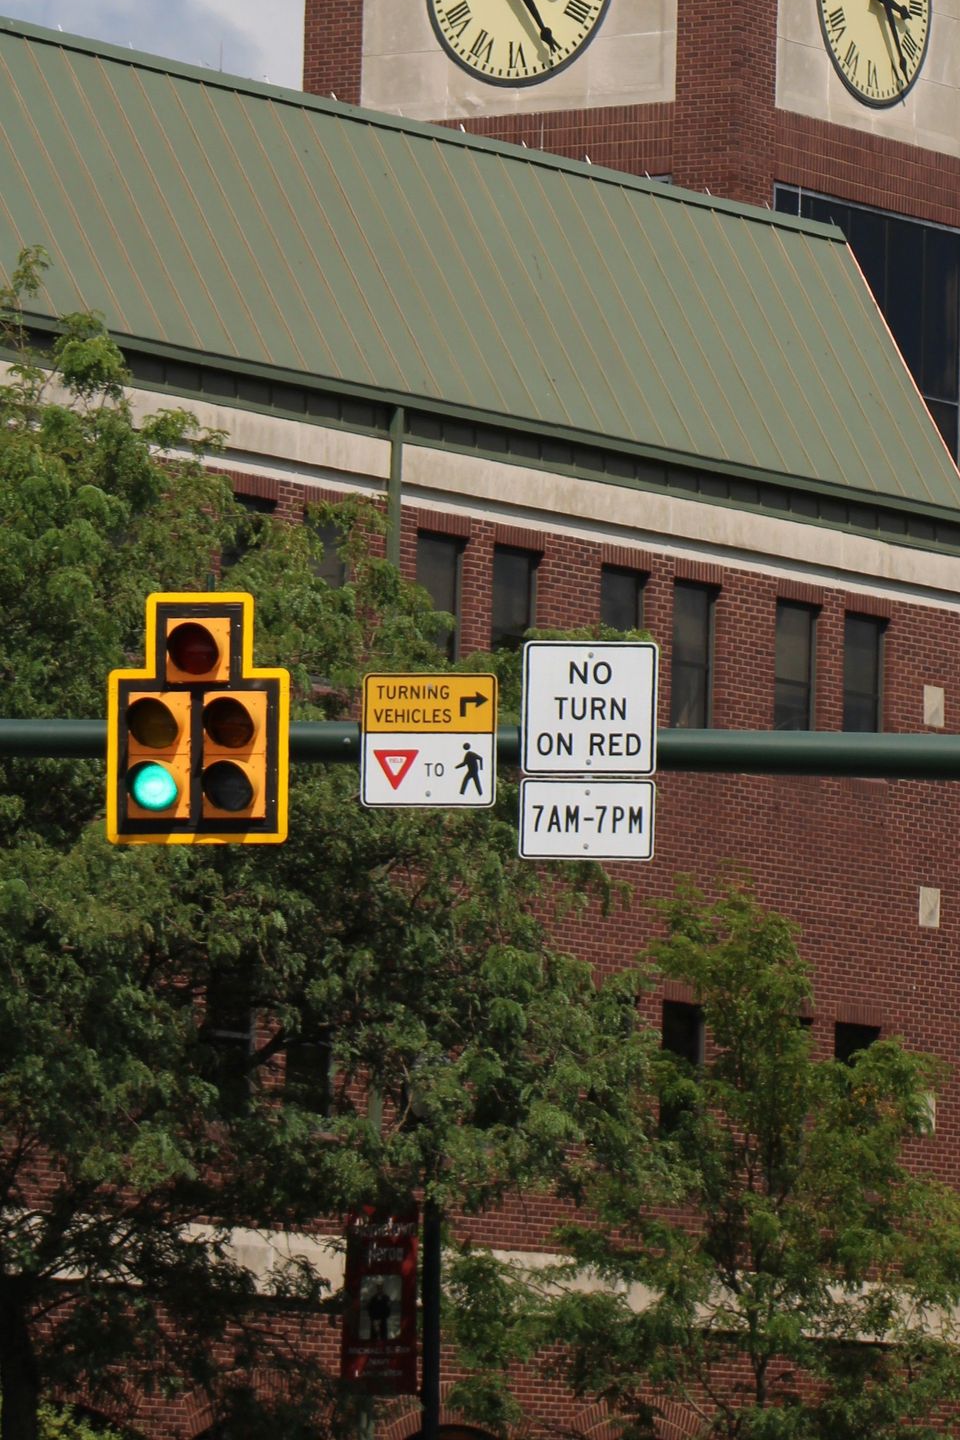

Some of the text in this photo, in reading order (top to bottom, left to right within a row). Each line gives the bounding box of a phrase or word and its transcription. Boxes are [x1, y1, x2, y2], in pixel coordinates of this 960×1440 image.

[908, 0, 923, 17] III
[469, 29, 494, 64] VII
[508, 41, 526, 69] VI
[843, 41, 859, 74] VII
[867, 59, 878, 89] VI
[569, 661, 612, 684] NO
[376, 685, 450, 700] TURNING
[374, 708, 452, 724] VEHICLES
[554, 697, 627, 720] TURN
[537, 732, 642, 756] ON RED
[424, 762, 445, 777] TO
[532, 805, 643, 834] 7AM-7PM
